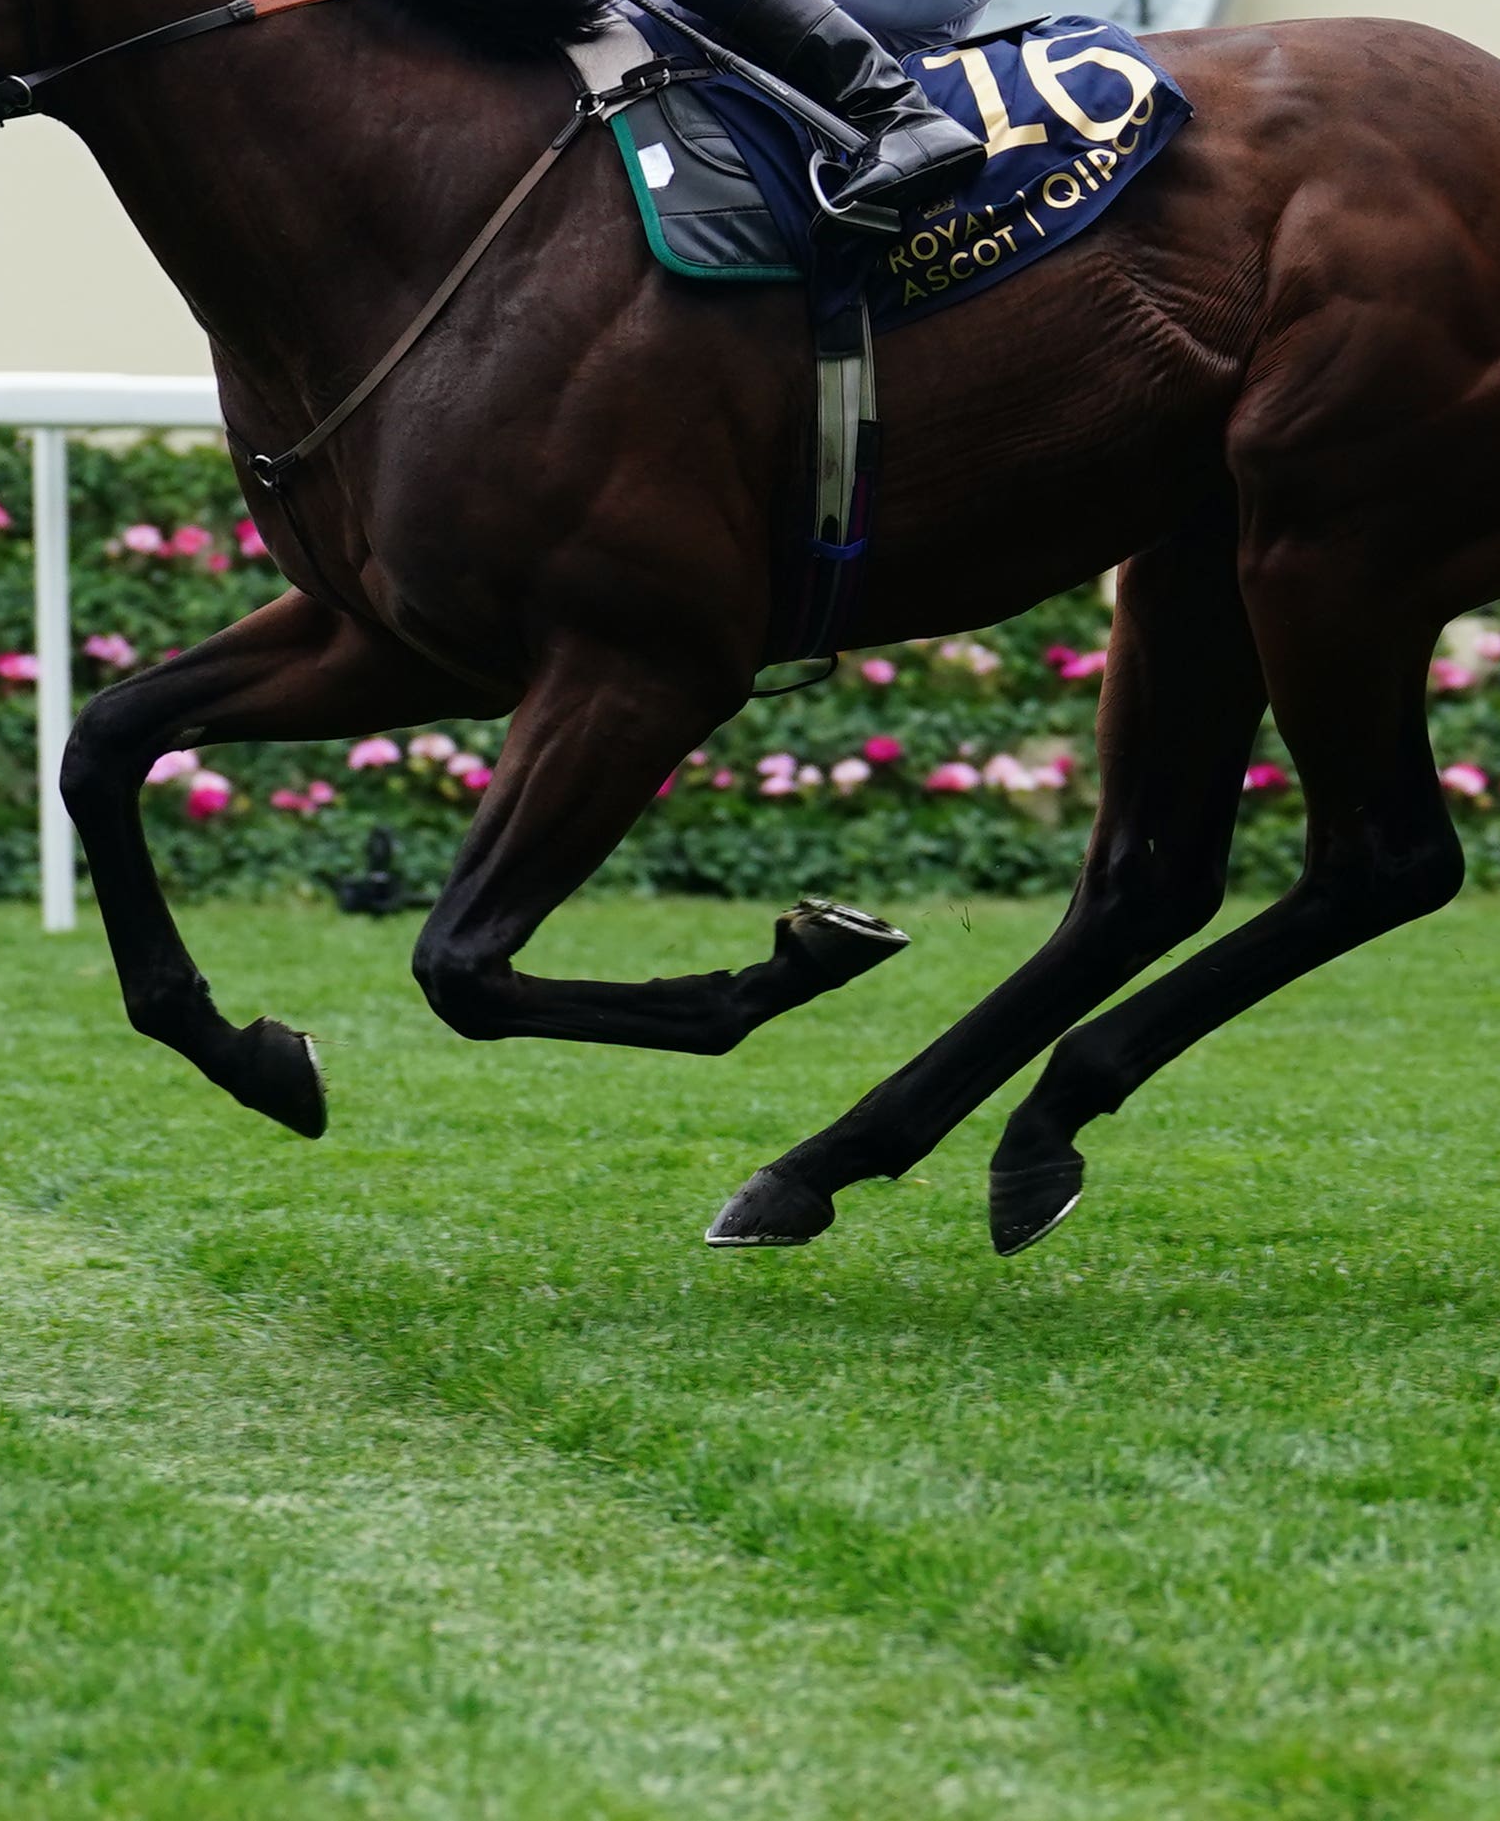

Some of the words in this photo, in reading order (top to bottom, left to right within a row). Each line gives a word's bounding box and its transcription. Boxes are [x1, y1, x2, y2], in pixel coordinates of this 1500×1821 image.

[921, 25, 1158, 160] 16
[1042, 92, 1154, 209] QIPCO
[888, 204, 1001, 275] ROYAL
[902, 224, 1019, 307] ASCOT
